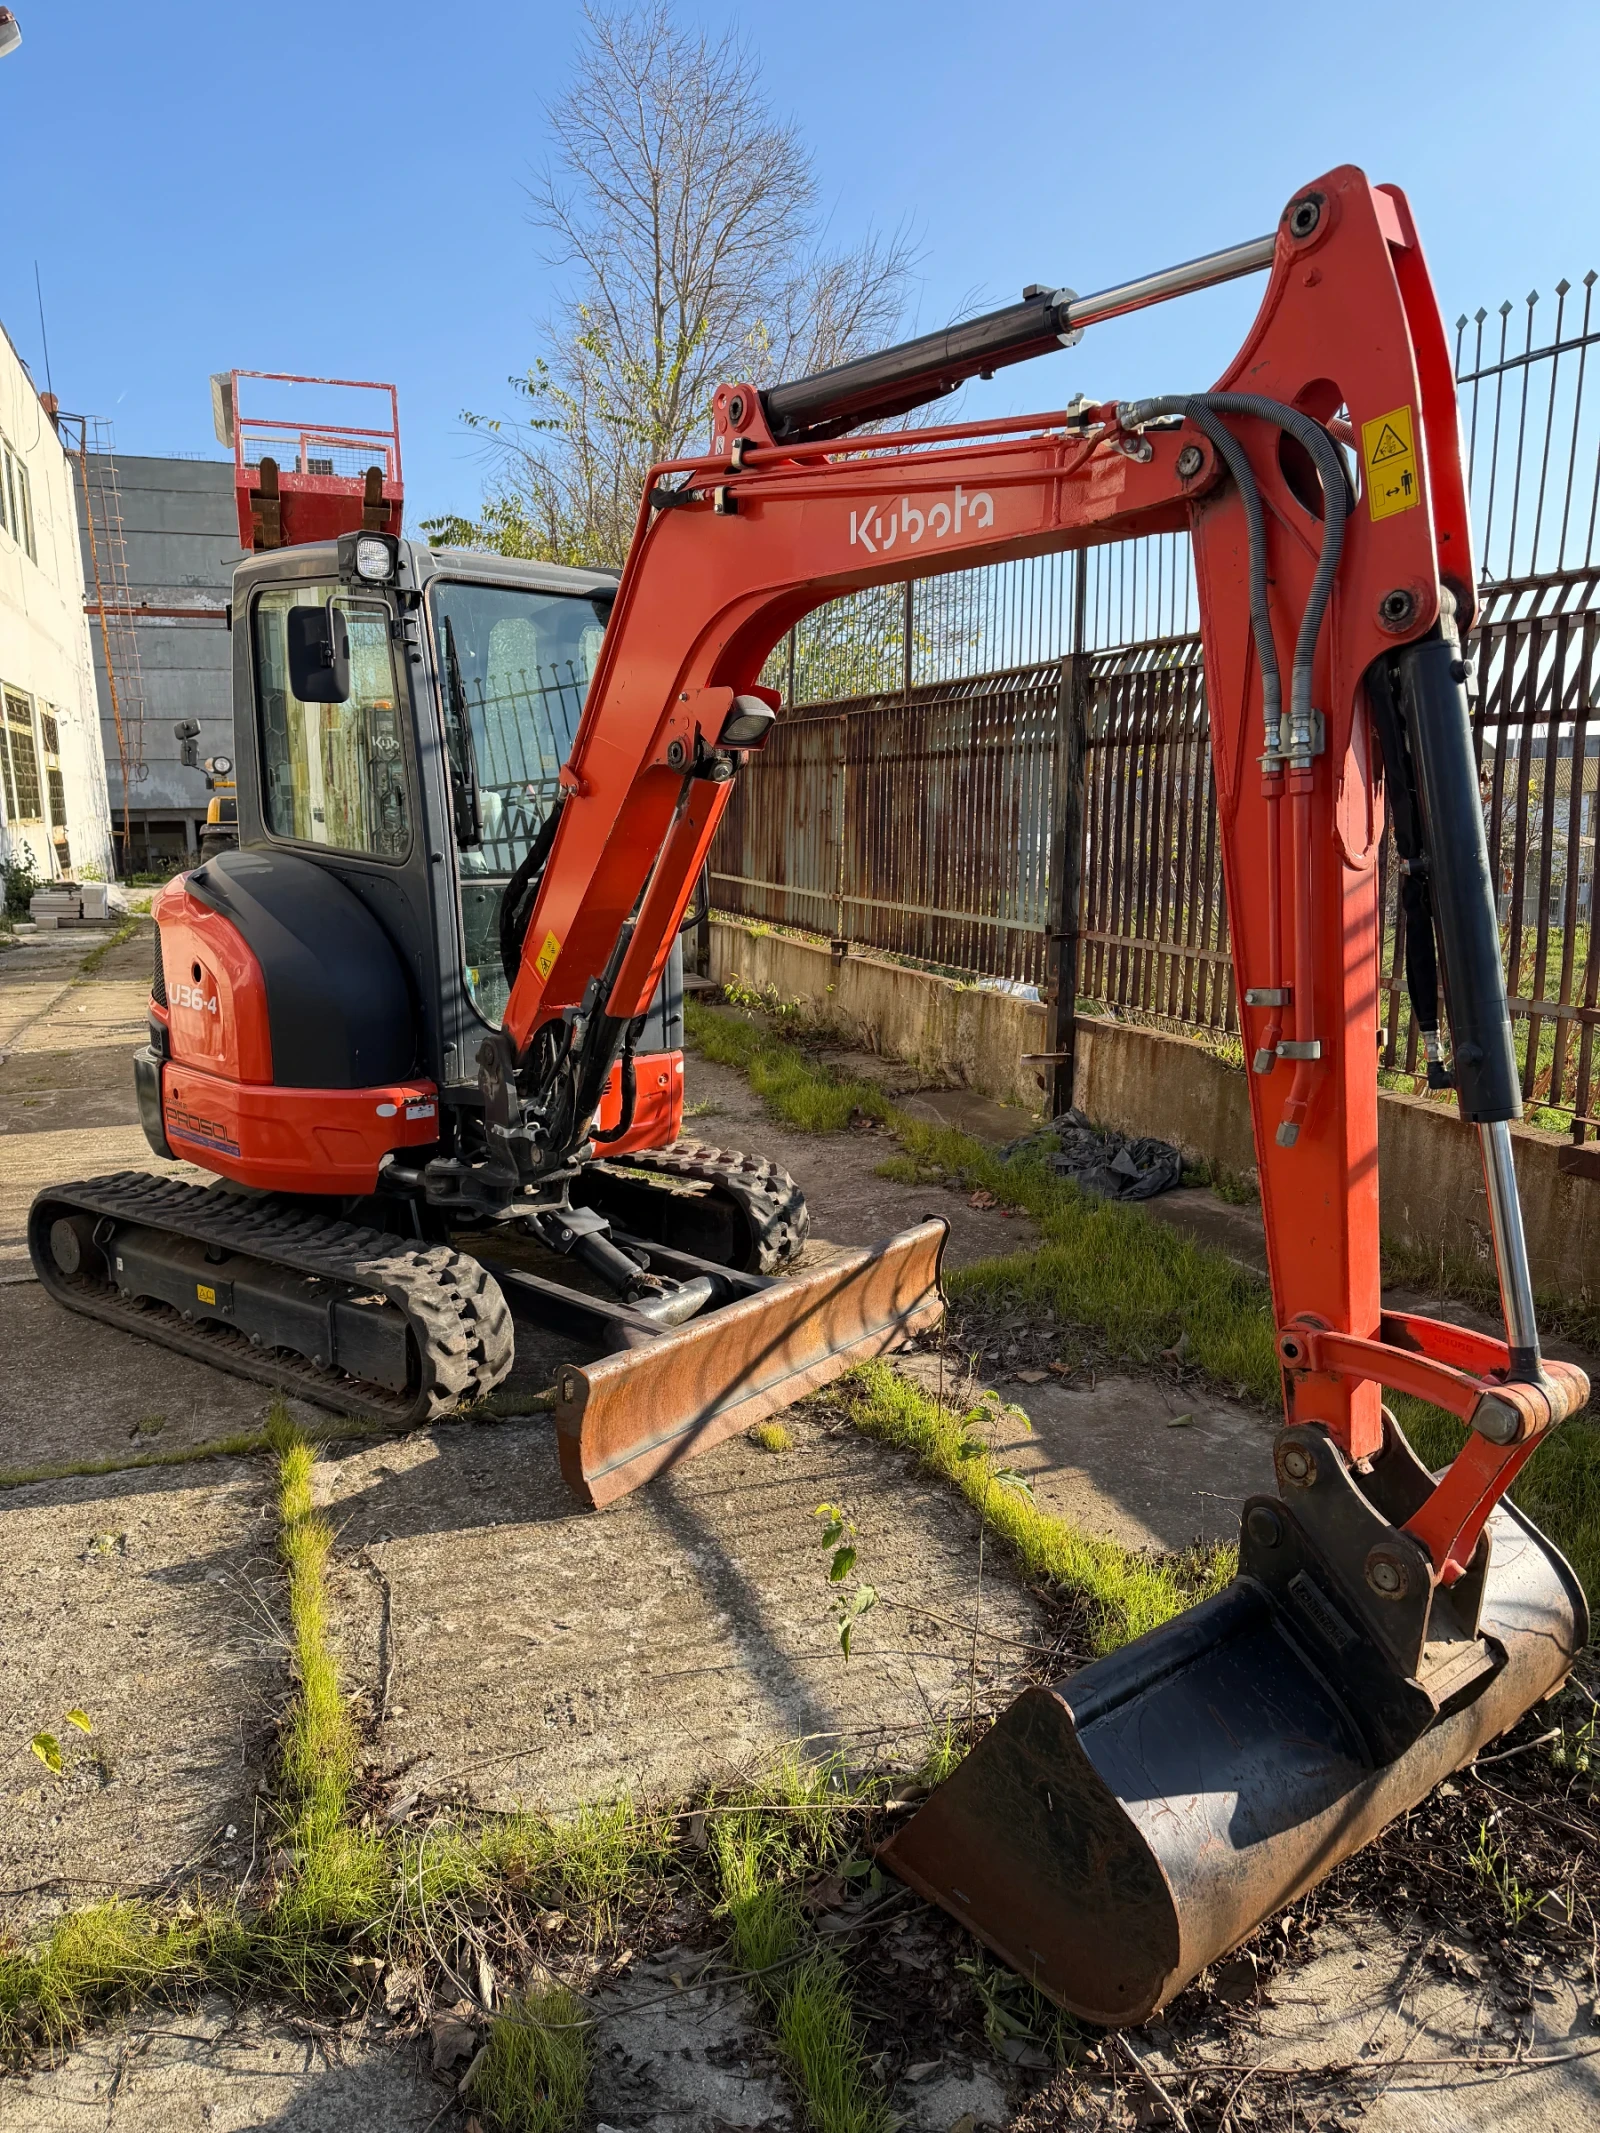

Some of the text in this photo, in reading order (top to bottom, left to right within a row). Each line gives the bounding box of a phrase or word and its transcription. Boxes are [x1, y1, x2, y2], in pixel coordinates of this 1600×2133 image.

[850, 485, 994, 553] Kubota
[168, 982, 217, 1015] U36-4
[166, 1107, 239, 1146] PROSOL
